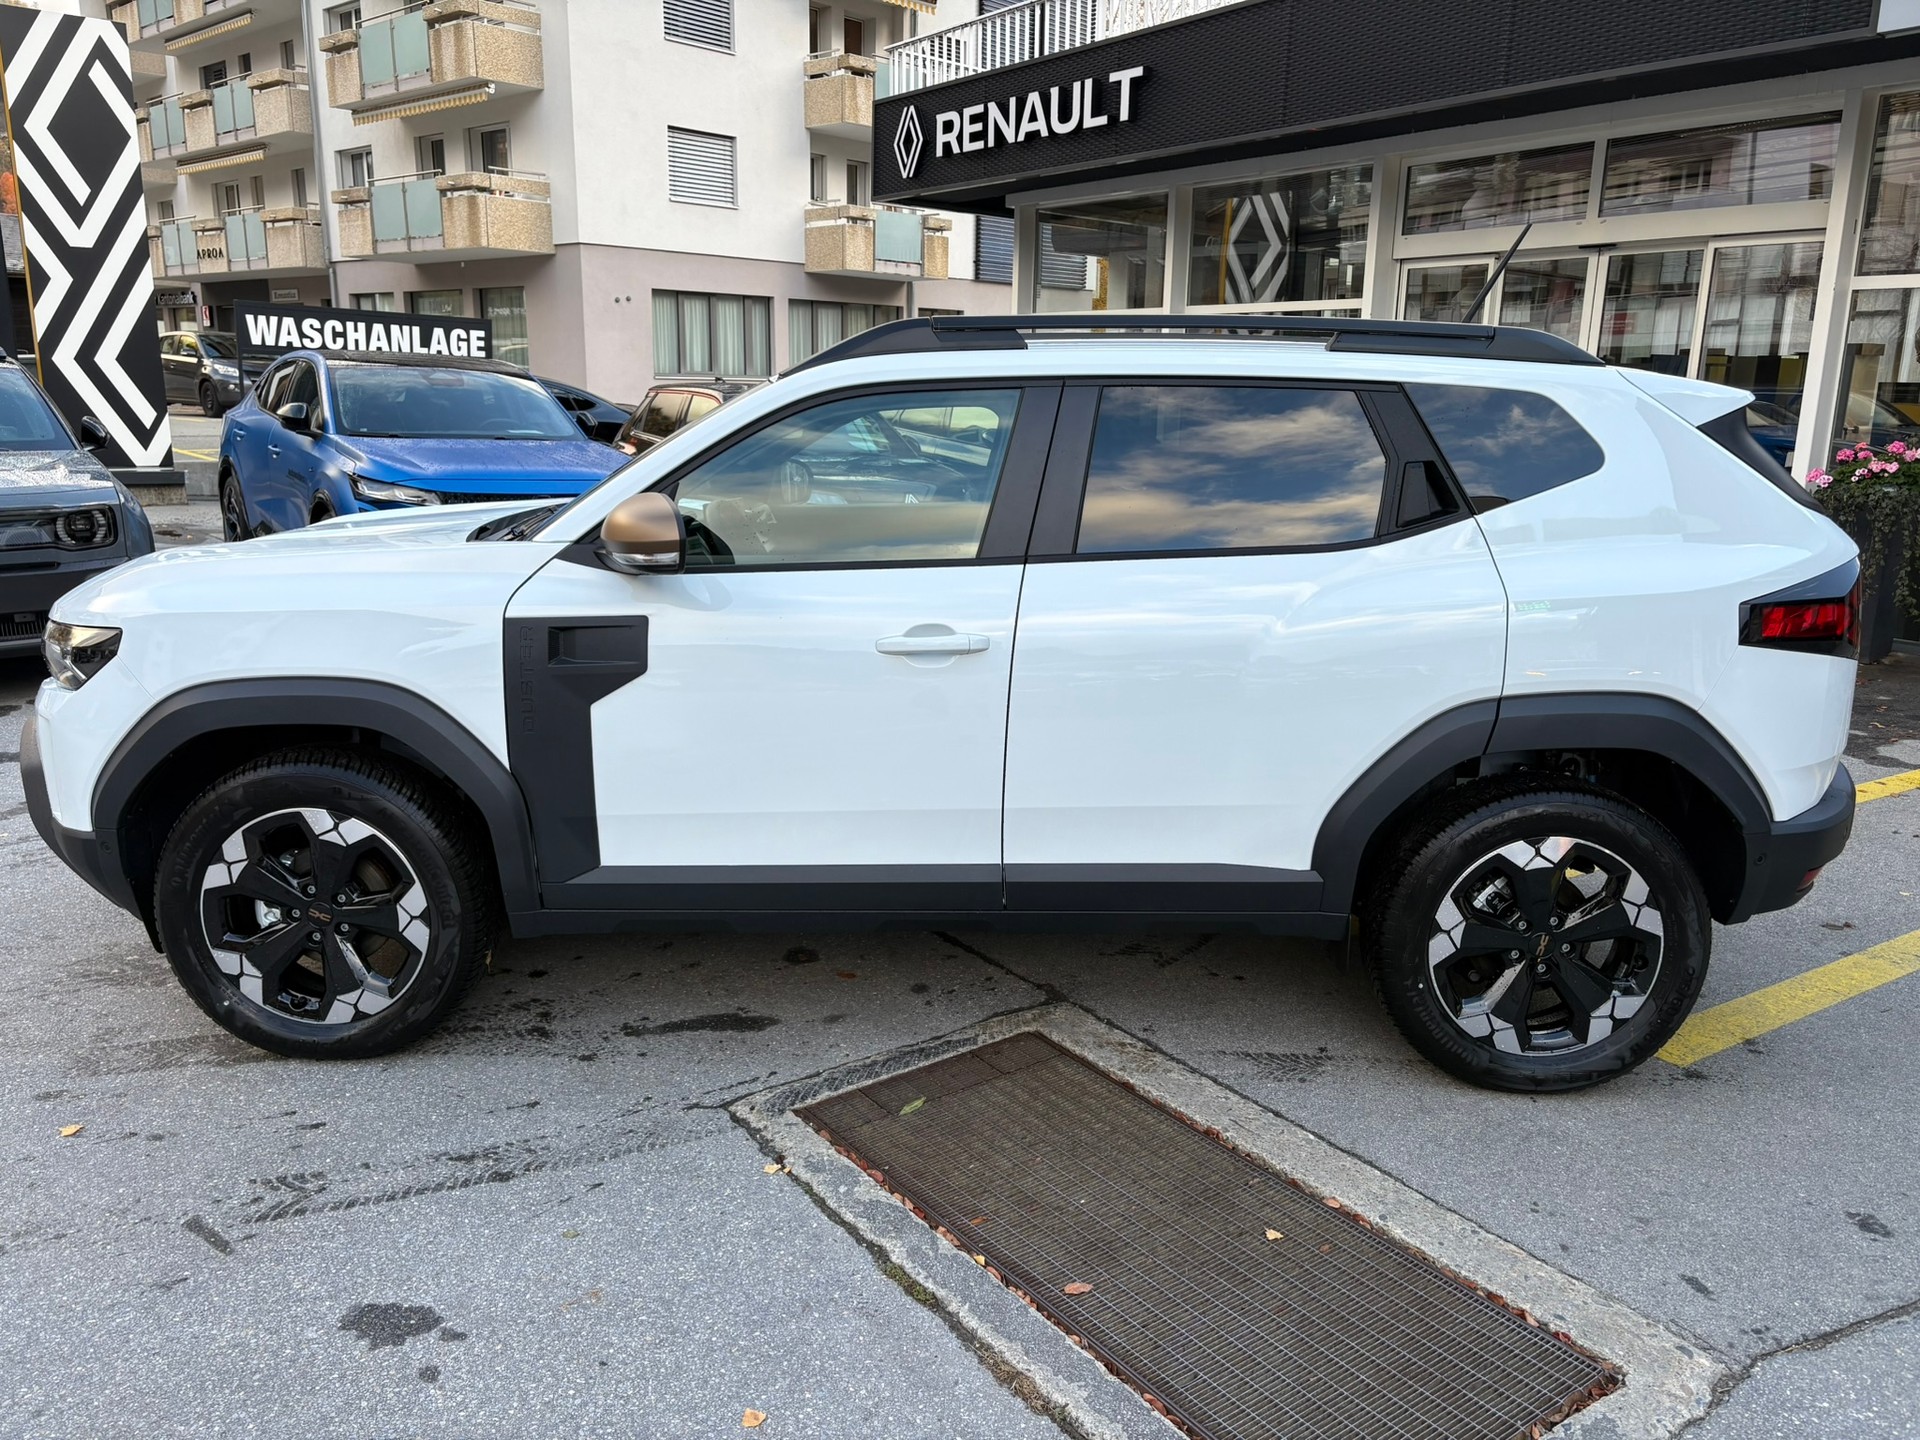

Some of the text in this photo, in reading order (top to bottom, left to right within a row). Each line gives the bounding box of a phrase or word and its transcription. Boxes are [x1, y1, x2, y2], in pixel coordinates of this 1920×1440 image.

[936, 66, 1144, 158] RENAULT
[197, 247, 224, 260] APROA
[245, 314, 486, 358] WASCHANLAGE
[519, 625, 537, 735] DUSTER
